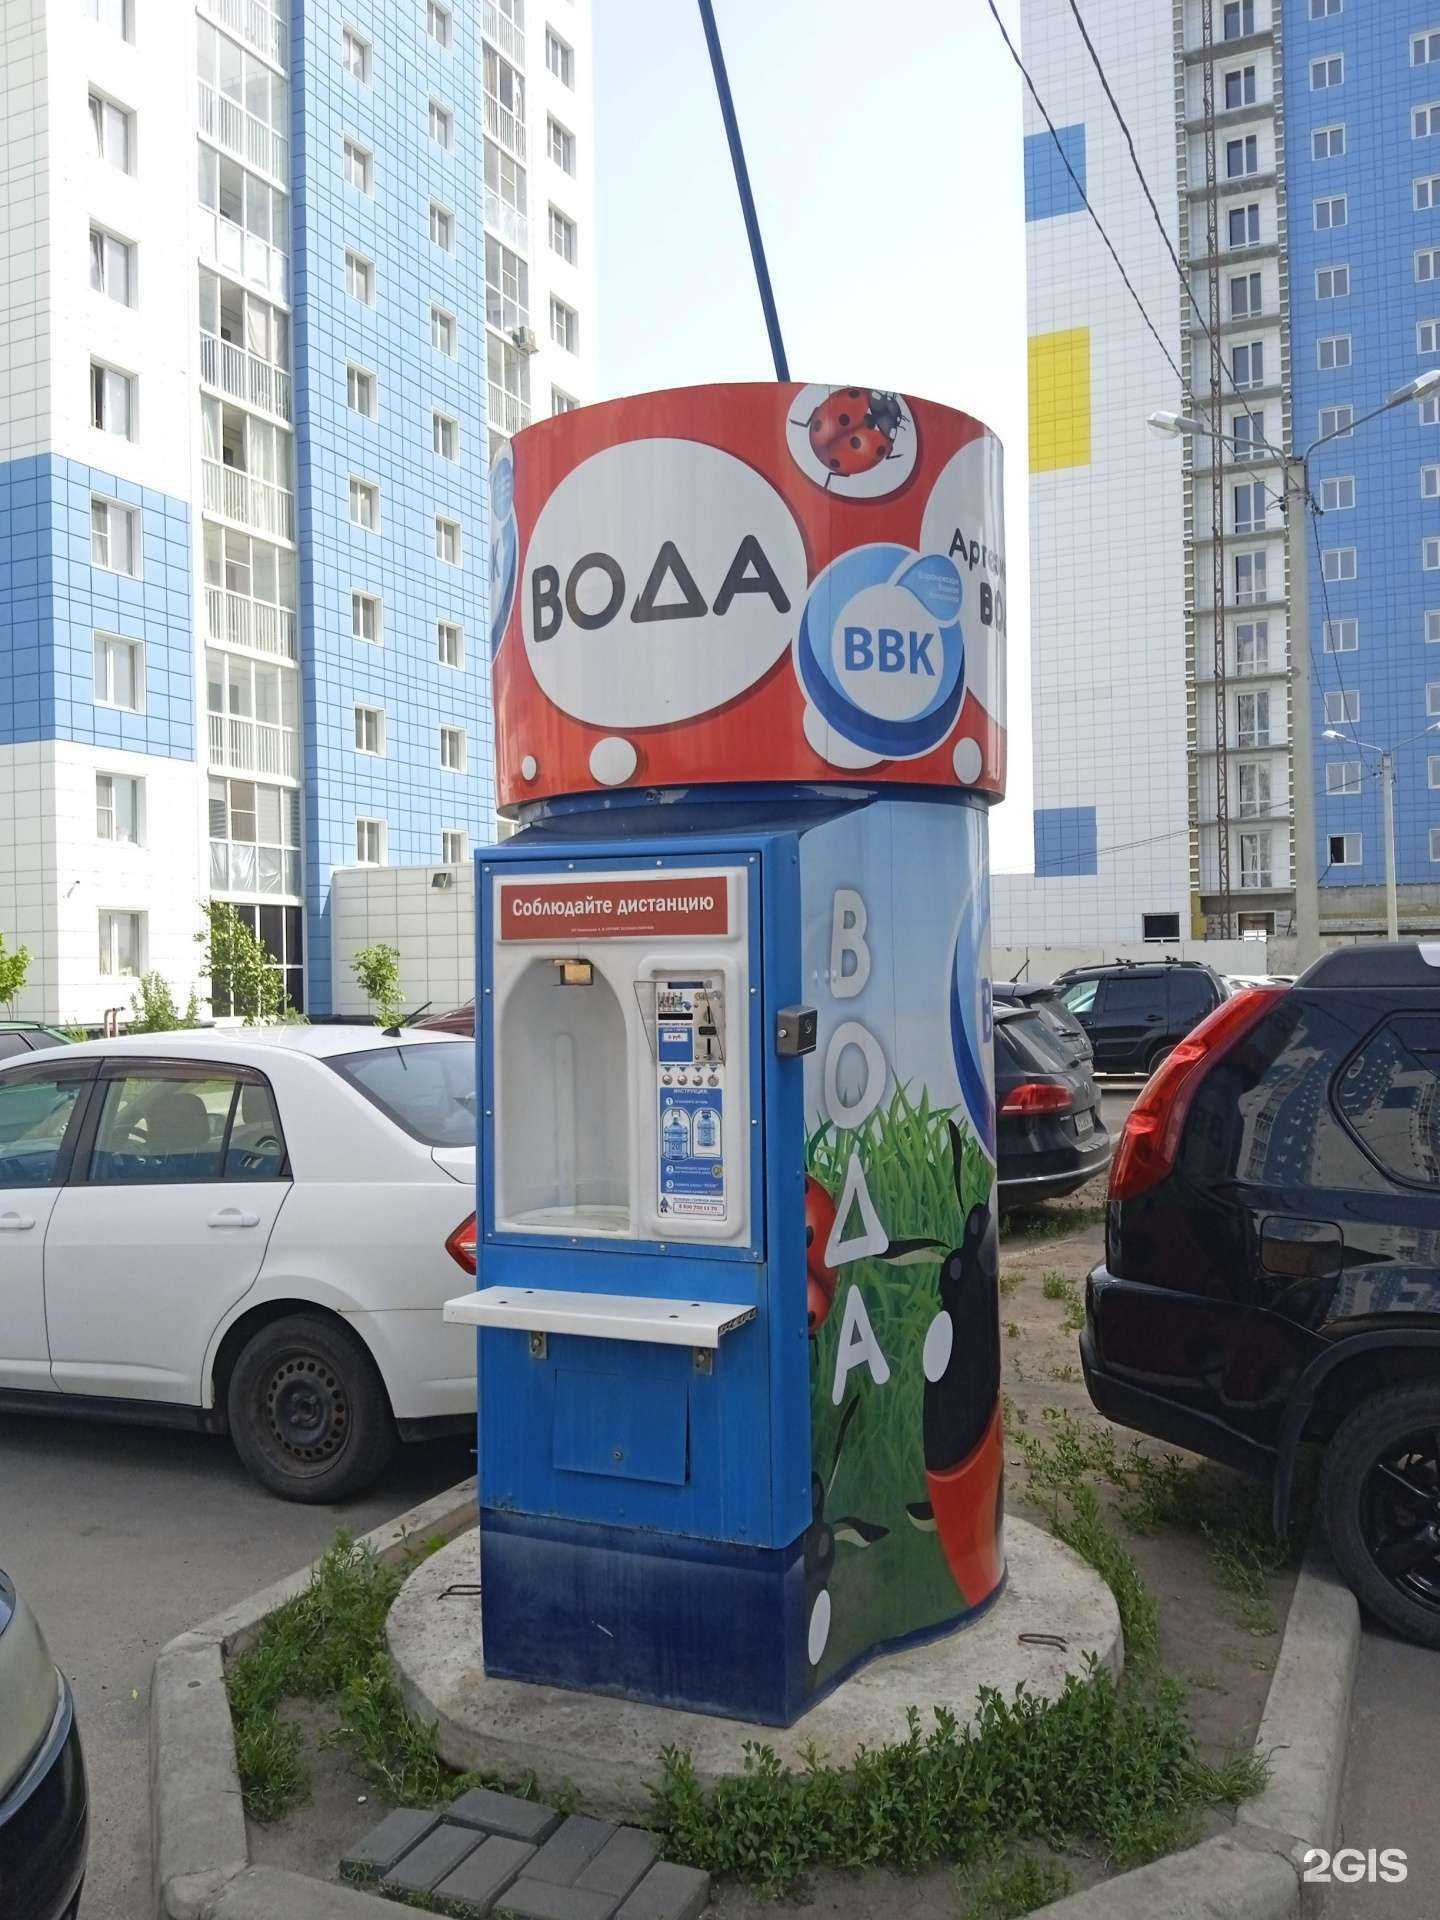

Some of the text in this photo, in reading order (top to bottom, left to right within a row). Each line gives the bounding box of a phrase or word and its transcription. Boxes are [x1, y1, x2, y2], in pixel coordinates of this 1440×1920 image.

[532, 534, 792, 643] ВОДА
[843, 626, 937, 676] ВВК
[512, 894, 714, 918] Соблюдайте дистанцию
[824, 889, 890, 1406] ВОДА
